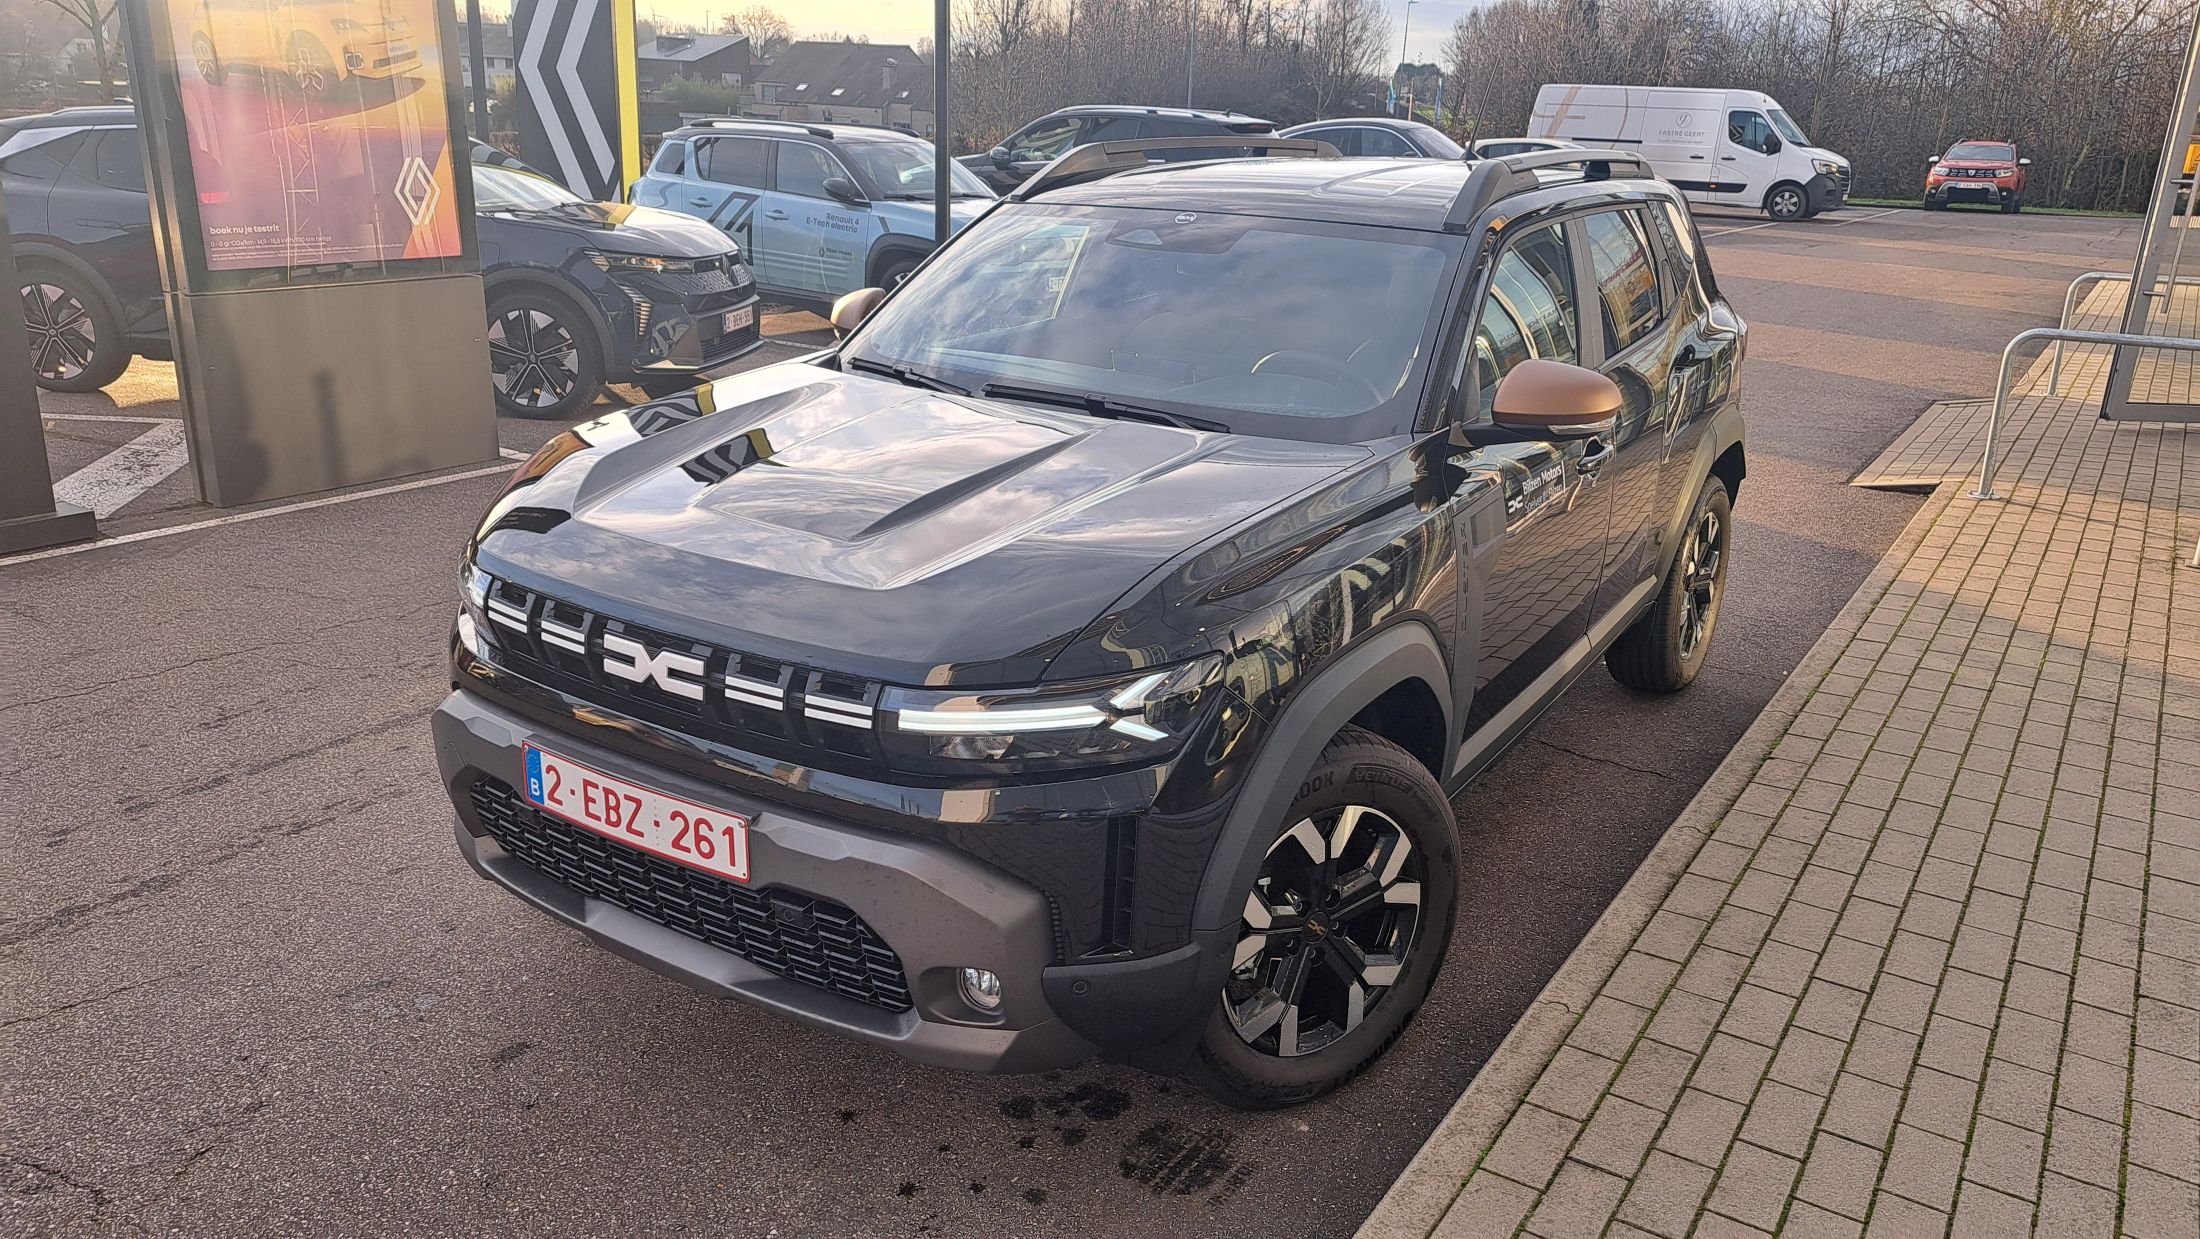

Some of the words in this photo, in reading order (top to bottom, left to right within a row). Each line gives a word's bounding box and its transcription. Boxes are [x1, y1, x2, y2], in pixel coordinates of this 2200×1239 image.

[806, 217, 830, 228] E-Tech
[830, 222, 858, 233] electric
[826, 212, 854, 224] Renault
[209, 226, 232, 235] boek
[233, 226, 244, 234] nu
[253, 224, 280, 233] testrit
[1522, 477, 1542, 495] Bilzen
[1541, 465, 1562, 485] Motors
[530, 778, 541, 796] B
